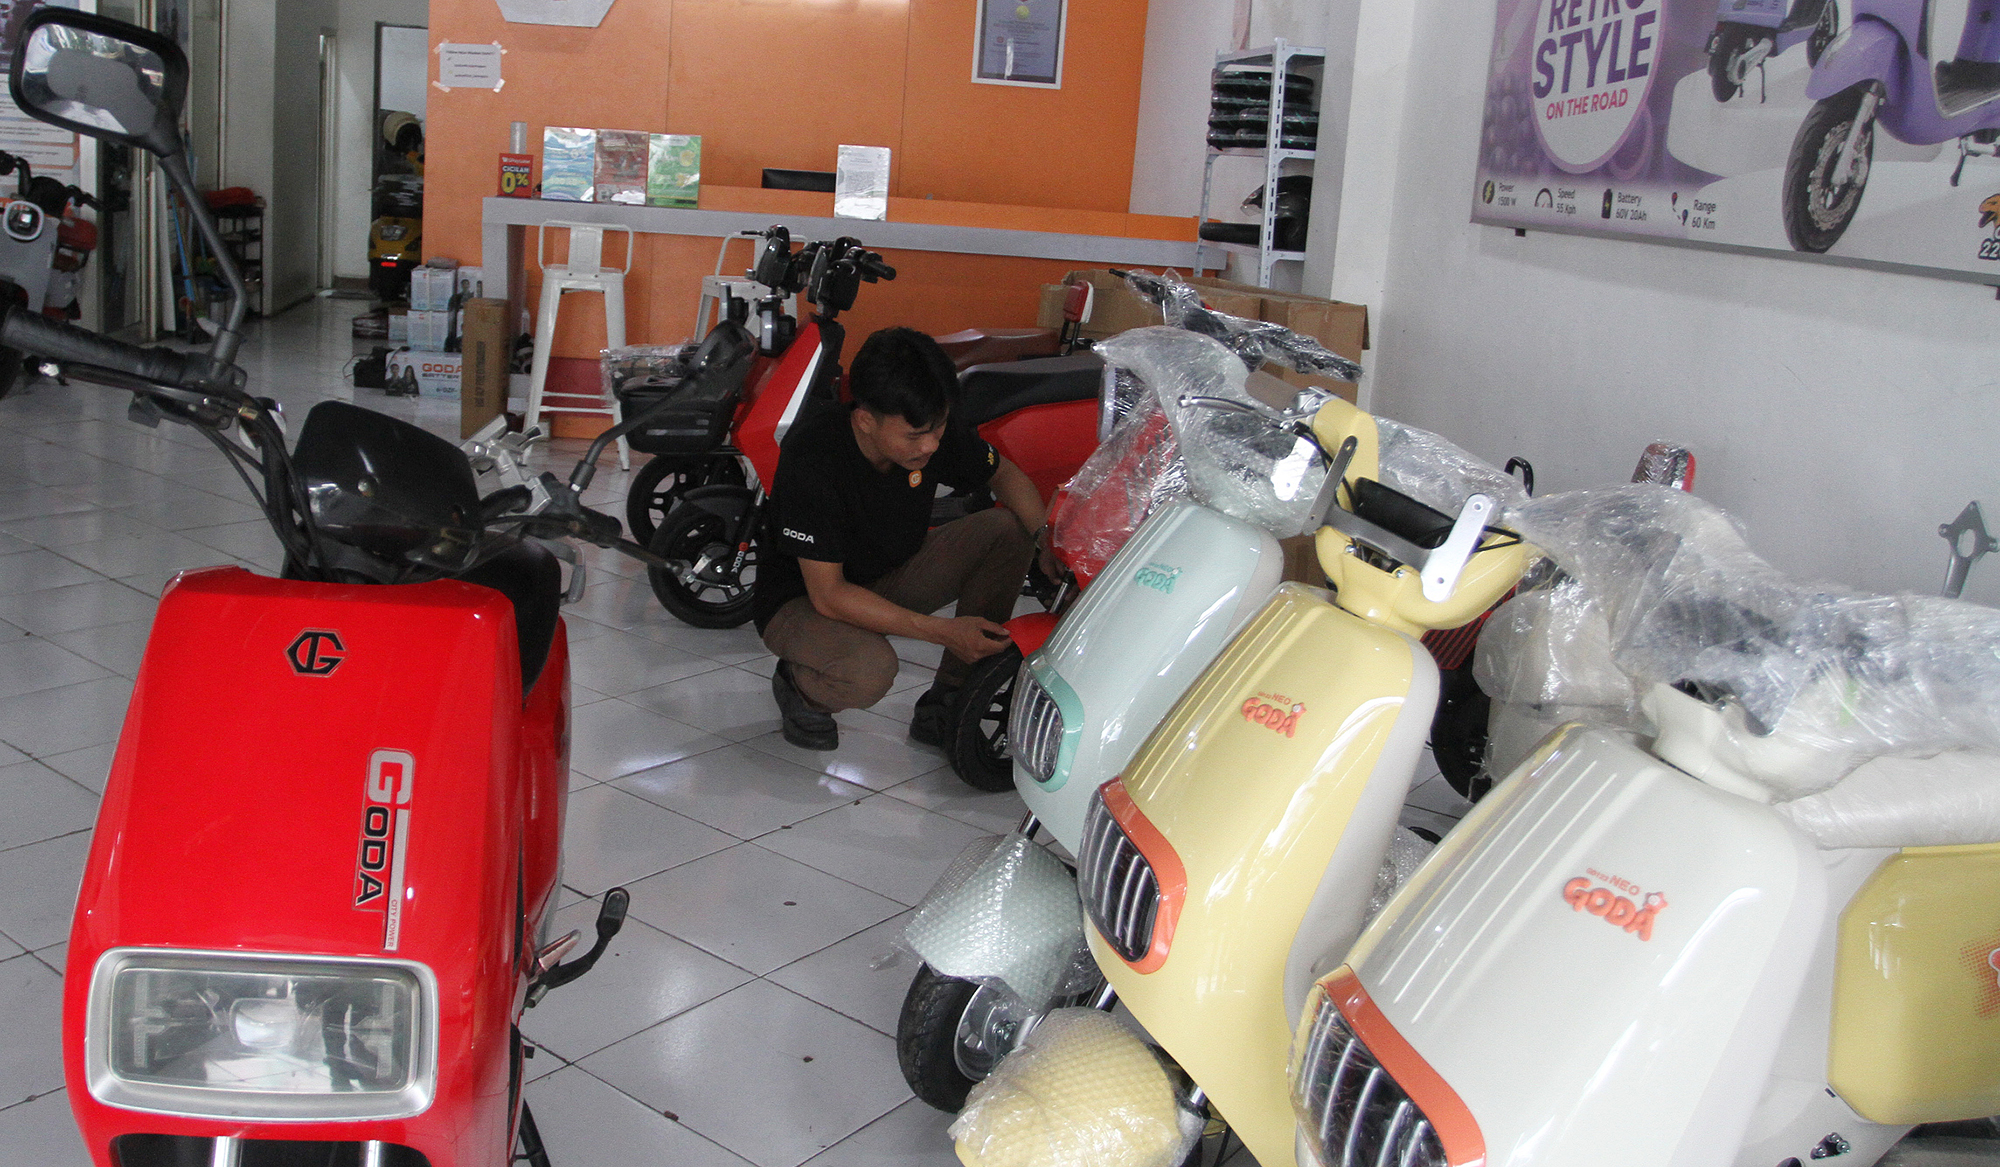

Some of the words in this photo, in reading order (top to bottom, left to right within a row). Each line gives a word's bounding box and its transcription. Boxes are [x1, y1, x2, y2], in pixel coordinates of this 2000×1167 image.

[1533, 10, 1656, 99] STYLE
[1546, 101, 1565, 120] ON
[1567, 96, 1590, 116] THE
[1590, 88, 1629, 112] ROAD
[502, 172, 529, 193] 0%
[1557, 188, 1576, 199] Speed
[1618, 192, 1643, 206] Battery
[1556, 203, 1564, 213] 55
[1565, 204, 1577, 216] Kph
[1616, 208, 1629, 219] 60V
[1630, 209, 1648, 221] 20Ah
[1694, 199, 1717, 214] Range
[1692, 217, 1702, 228] 60
[1703, 218, 1716, 230] Km
[783, 528, 814, 544] GODA
[1134, 567, 1176, 594] GODA
[1272, 693, 1292, 706] NEO
[1241, 697, 1299, 738] GODA
[355, 750, 413, 906] GODA
[1609, 875, 1641, 896] NEO
[1563, 877, 1656, 942] GODA
[387, 918, 396, 948] POWER
